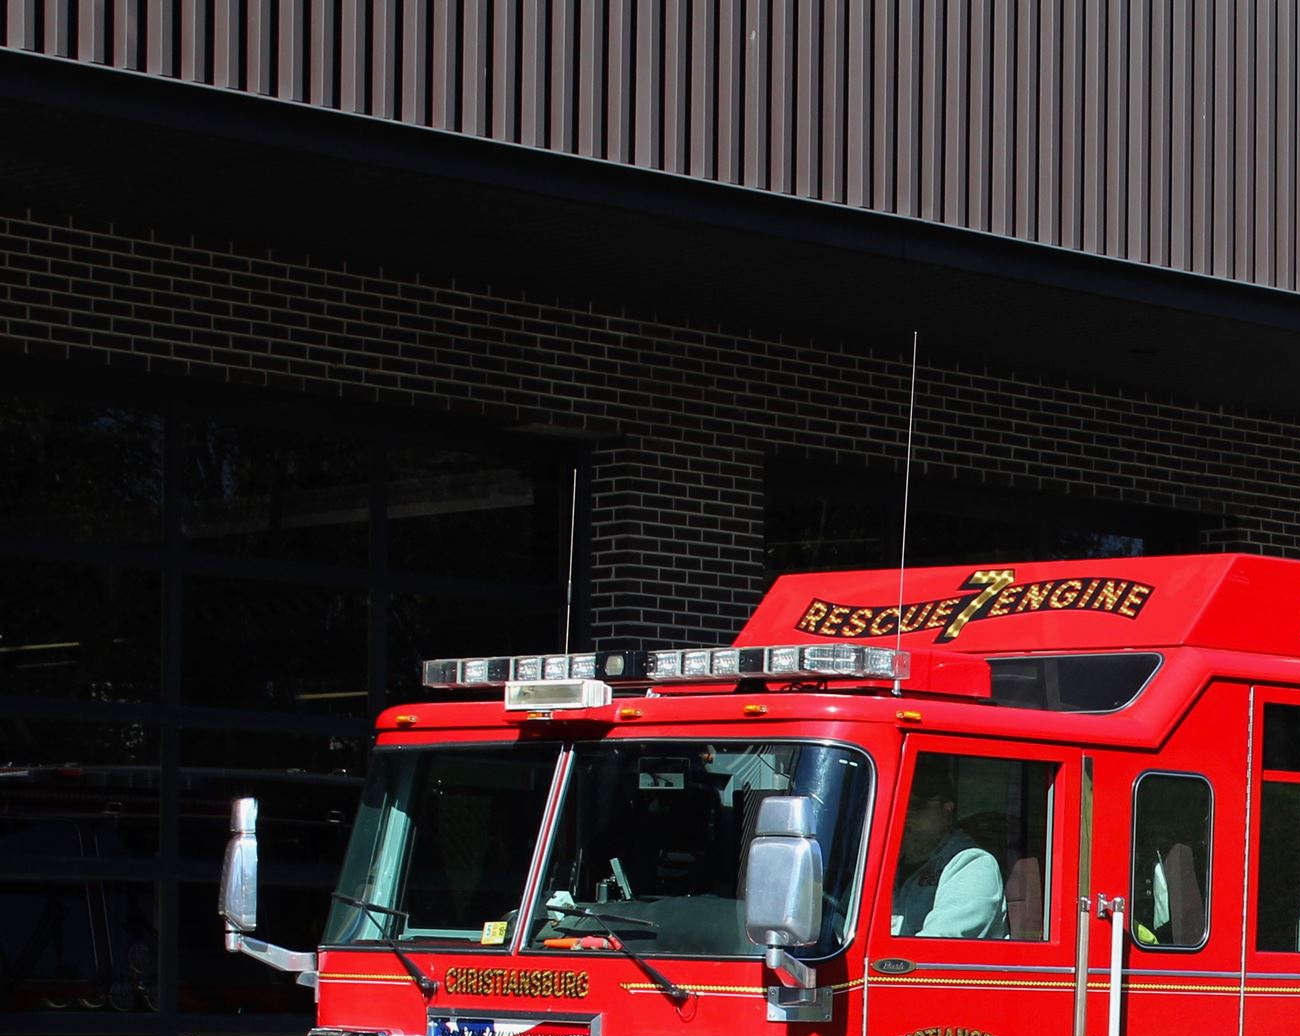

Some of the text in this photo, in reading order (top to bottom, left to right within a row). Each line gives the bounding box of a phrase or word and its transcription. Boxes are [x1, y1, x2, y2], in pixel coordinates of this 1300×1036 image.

[799, 568, 1152, 642] RESCUE 7 ENGINE
[445, 966, 590, 999] CHRISTIANSBURG
